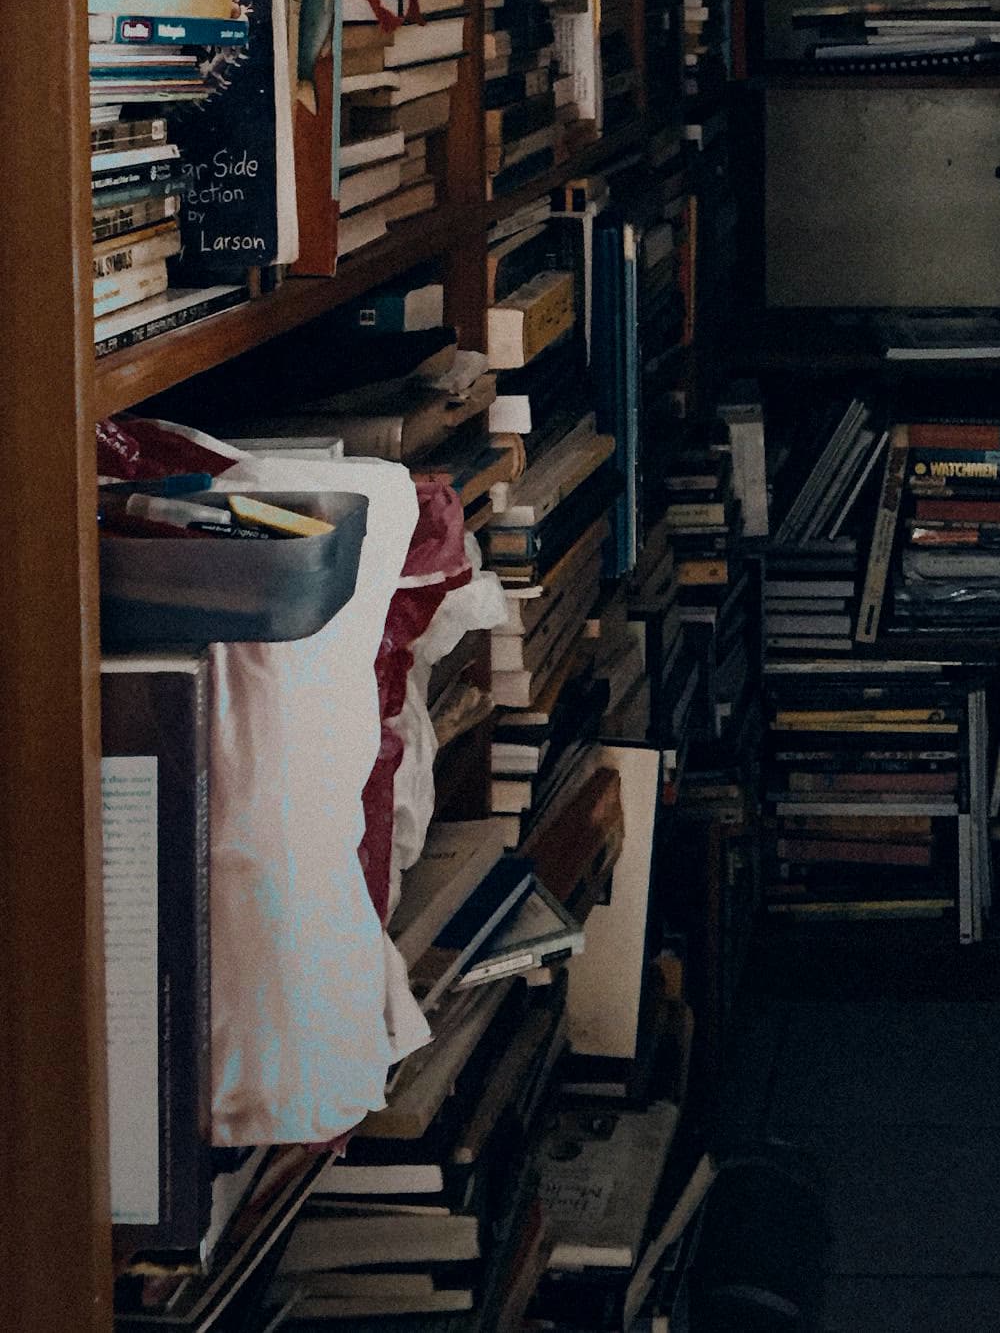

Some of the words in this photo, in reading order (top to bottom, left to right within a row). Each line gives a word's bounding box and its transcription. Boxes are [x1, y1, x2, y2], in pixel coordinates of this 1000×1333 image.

[181, 162, 208, 181] ar
[213, 148, 259, 179] Side
[183, 181, 245, 205] ection
[188, 210, 206, 224] by
[200, 230, 266, 253] Larson
[930, 461, 999, 479] WATCHMEN
